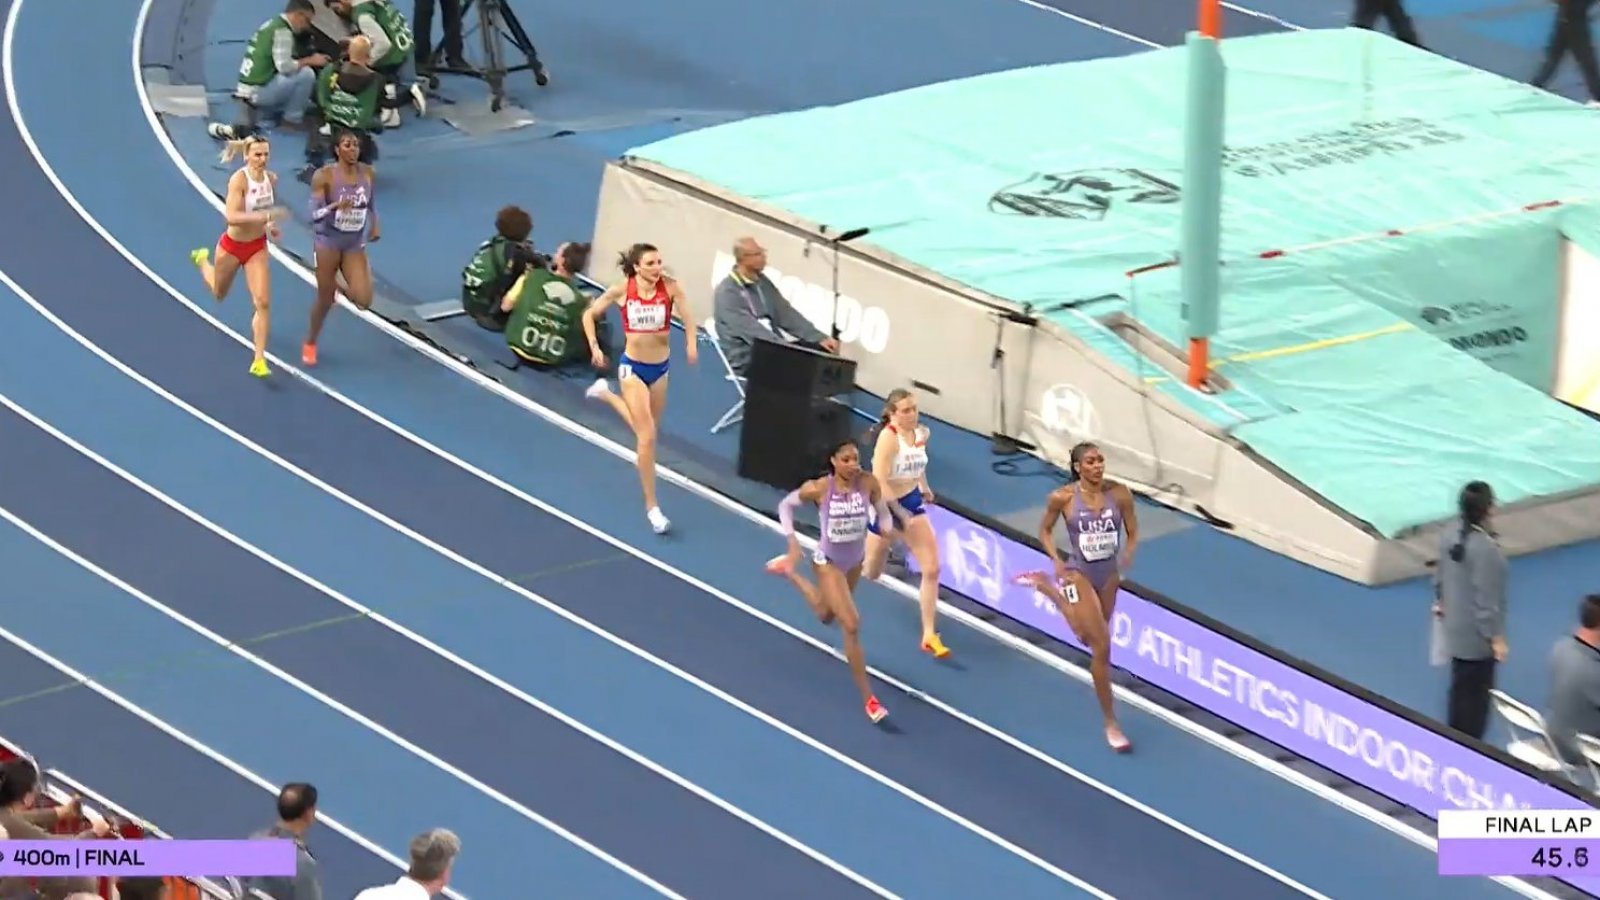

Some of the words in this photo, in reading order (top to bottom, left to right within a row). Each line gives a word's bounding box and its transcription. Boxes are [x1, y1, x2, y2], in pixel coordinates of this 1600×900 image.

[711, 250, 890, 354] ONDO
[521, 326, 567, 356] 010
[1448, 326, 1528, 351] MONDO
[1078, 518, 1116, 534] USA
[1137, 627, 1300, 729] ATHLETICS
[1303, 699, 1434, 793] INDOOR
